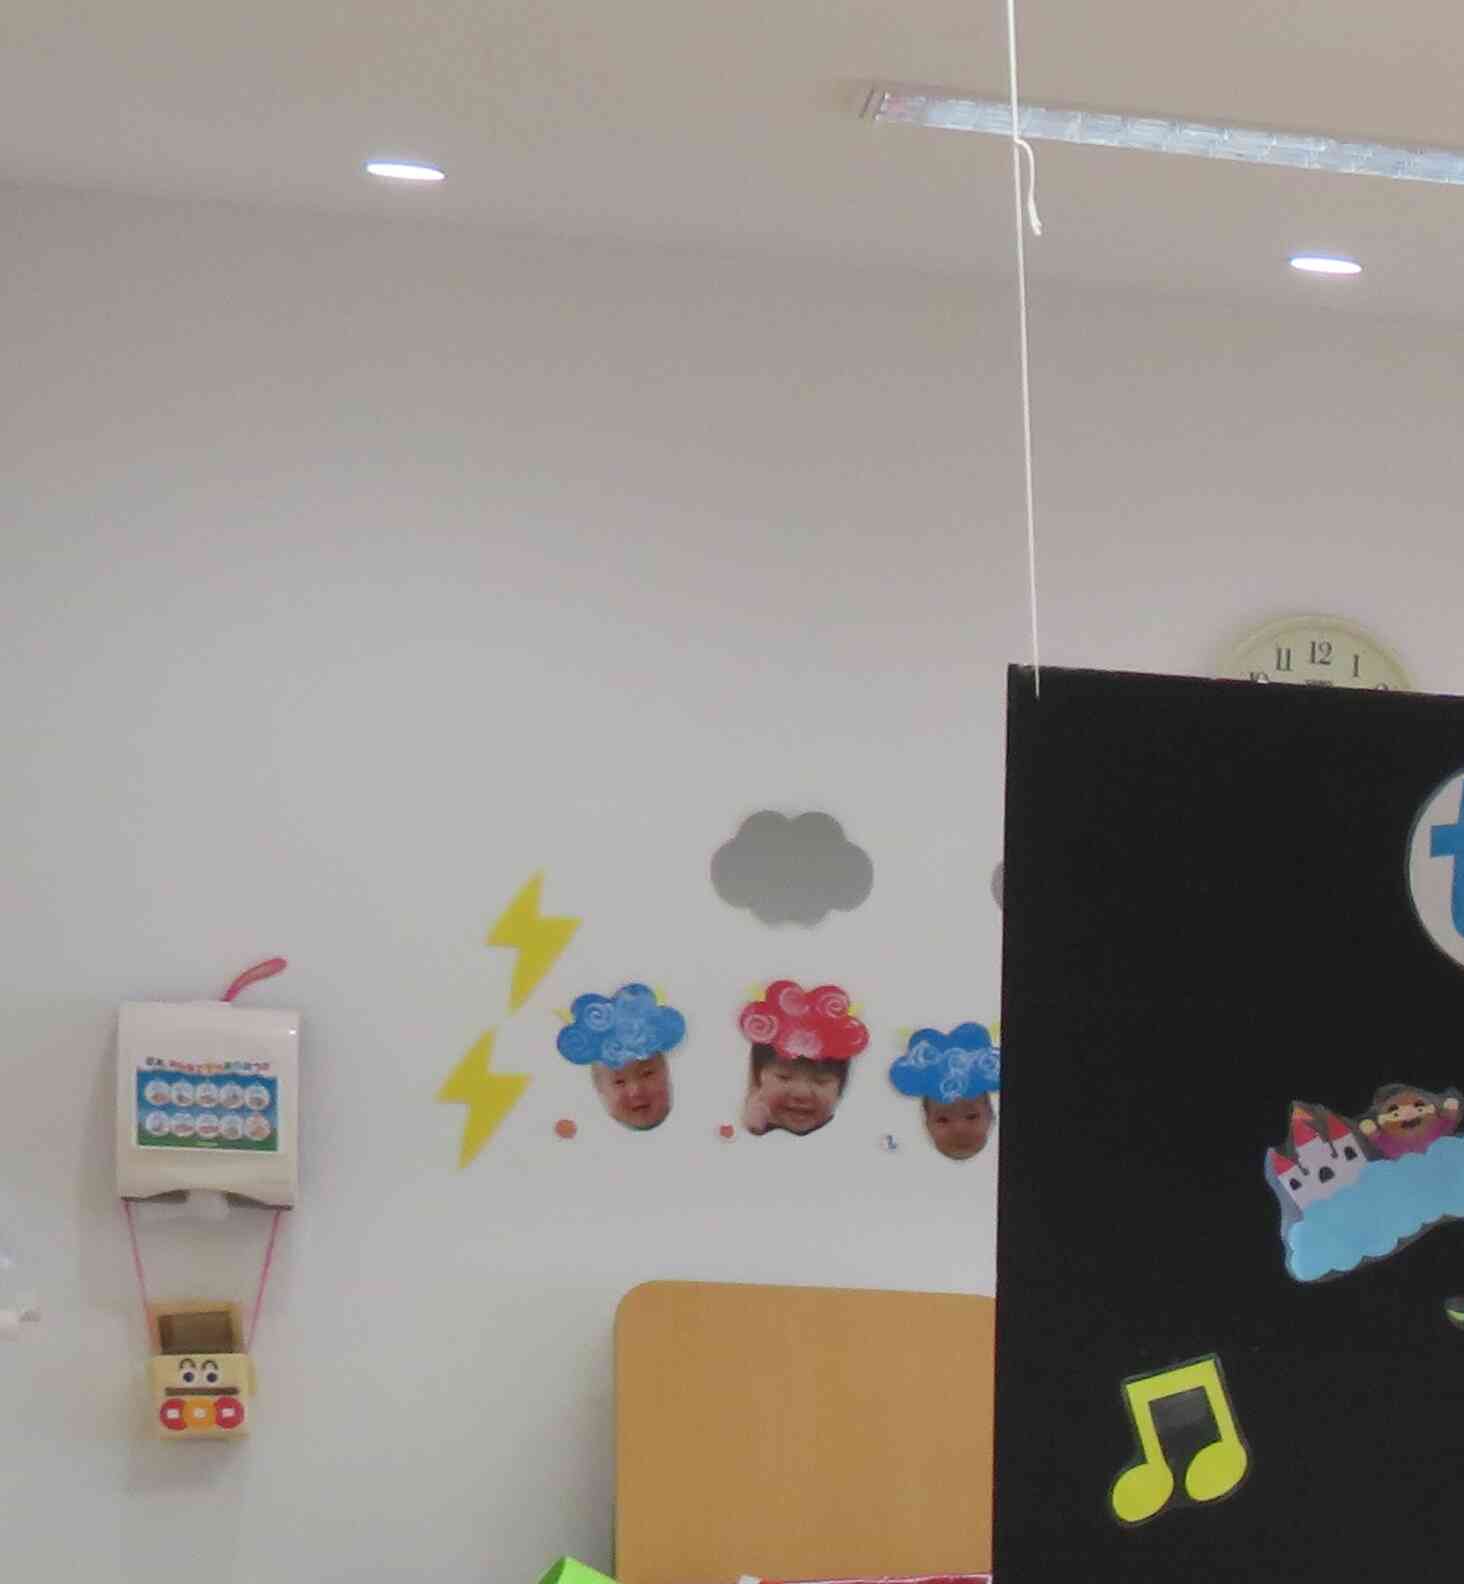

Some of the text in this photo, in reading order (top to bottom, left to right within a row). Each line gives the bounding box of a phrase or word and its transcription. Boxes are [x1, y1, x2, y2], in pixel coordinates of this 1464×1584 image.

[1275, 647, 1293, 672] 11
[1310, 640, 1333, 666] 12
[1352, 653, 1360, 678] 1
